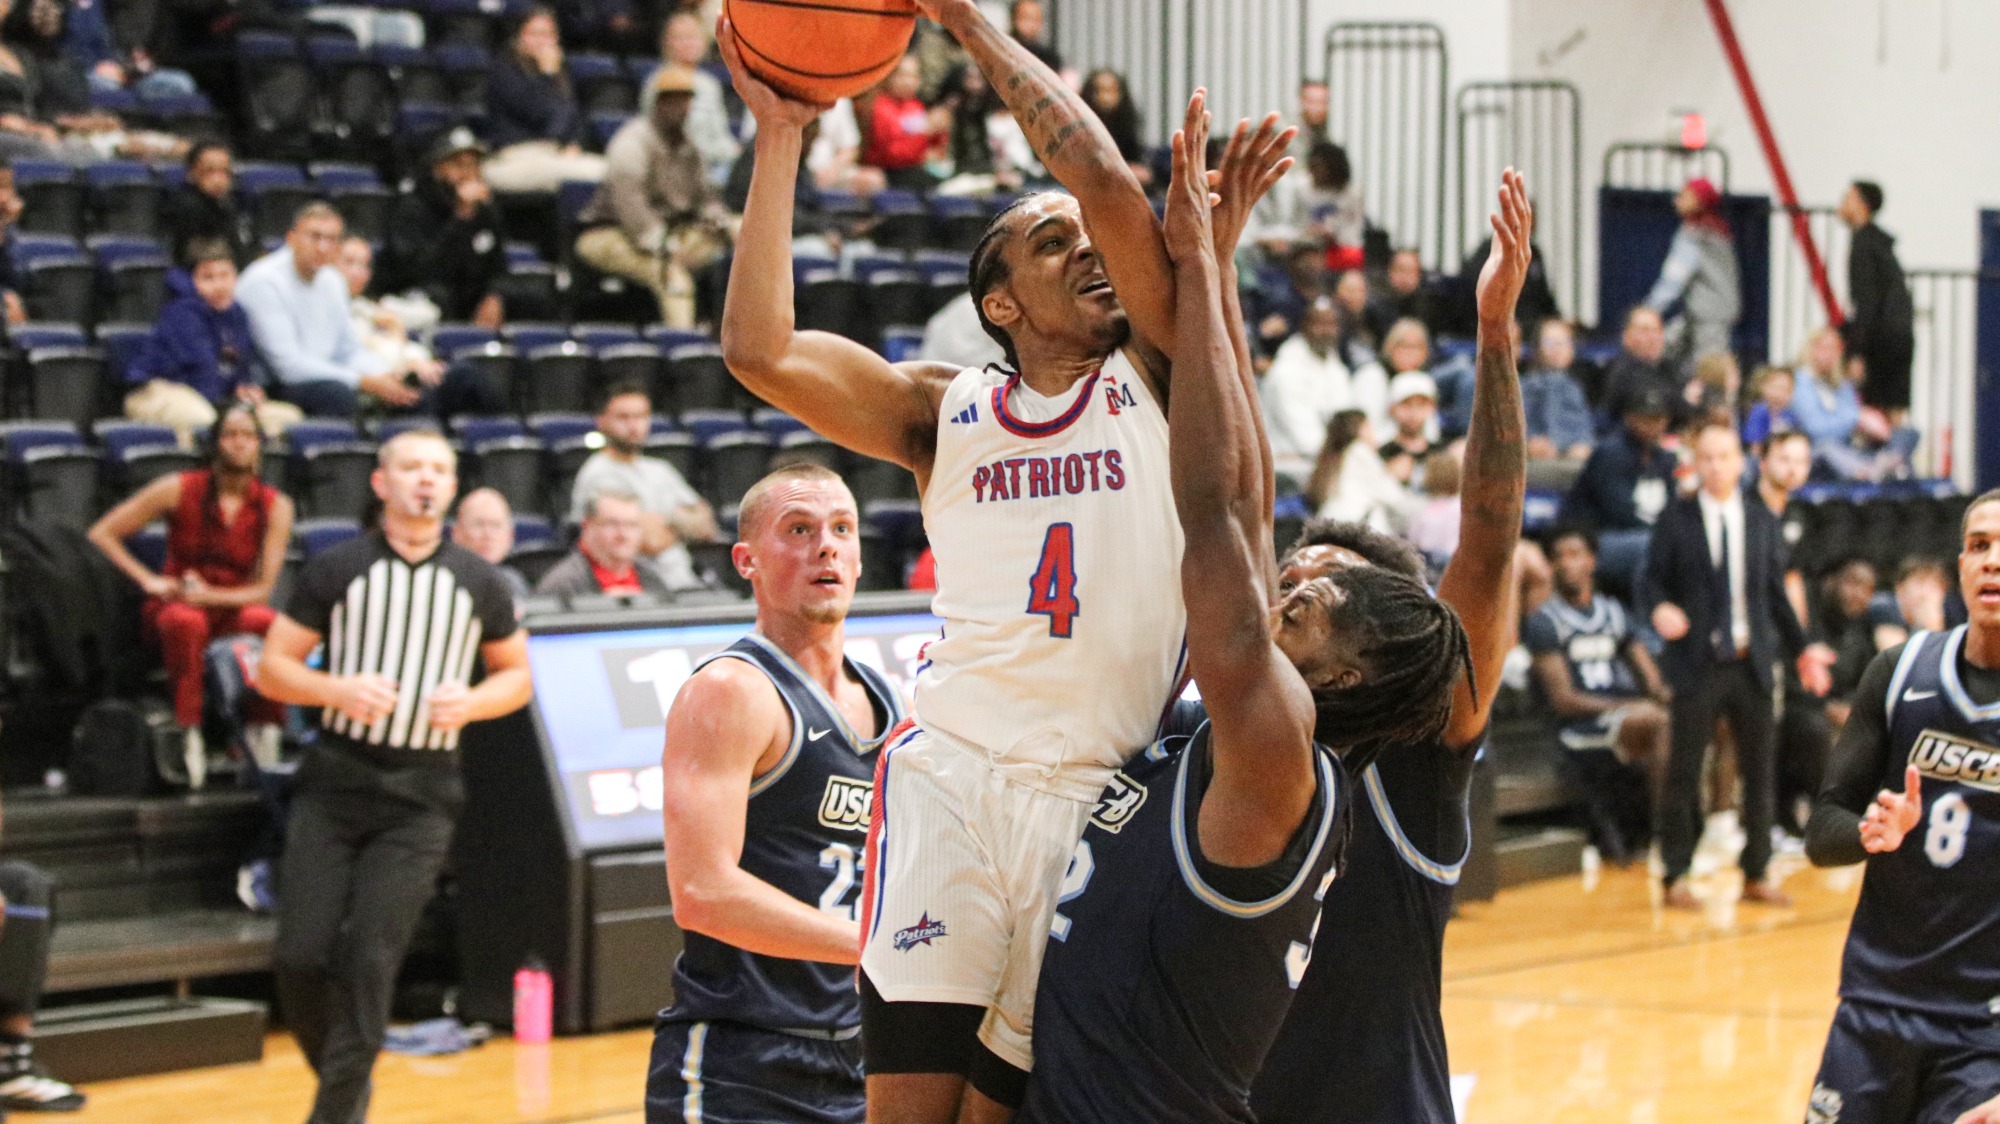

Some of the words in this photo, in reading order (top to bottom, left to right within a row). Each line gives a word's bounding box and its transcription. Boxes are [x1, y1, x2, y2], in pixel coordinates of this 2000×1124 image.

[972, 449, 1126, 503] PATRIOTS
[1025, 521, 1080, 639] 4
[1924, 791, 1972, 868] 8
[894, 922, 946, 949] Patriots
